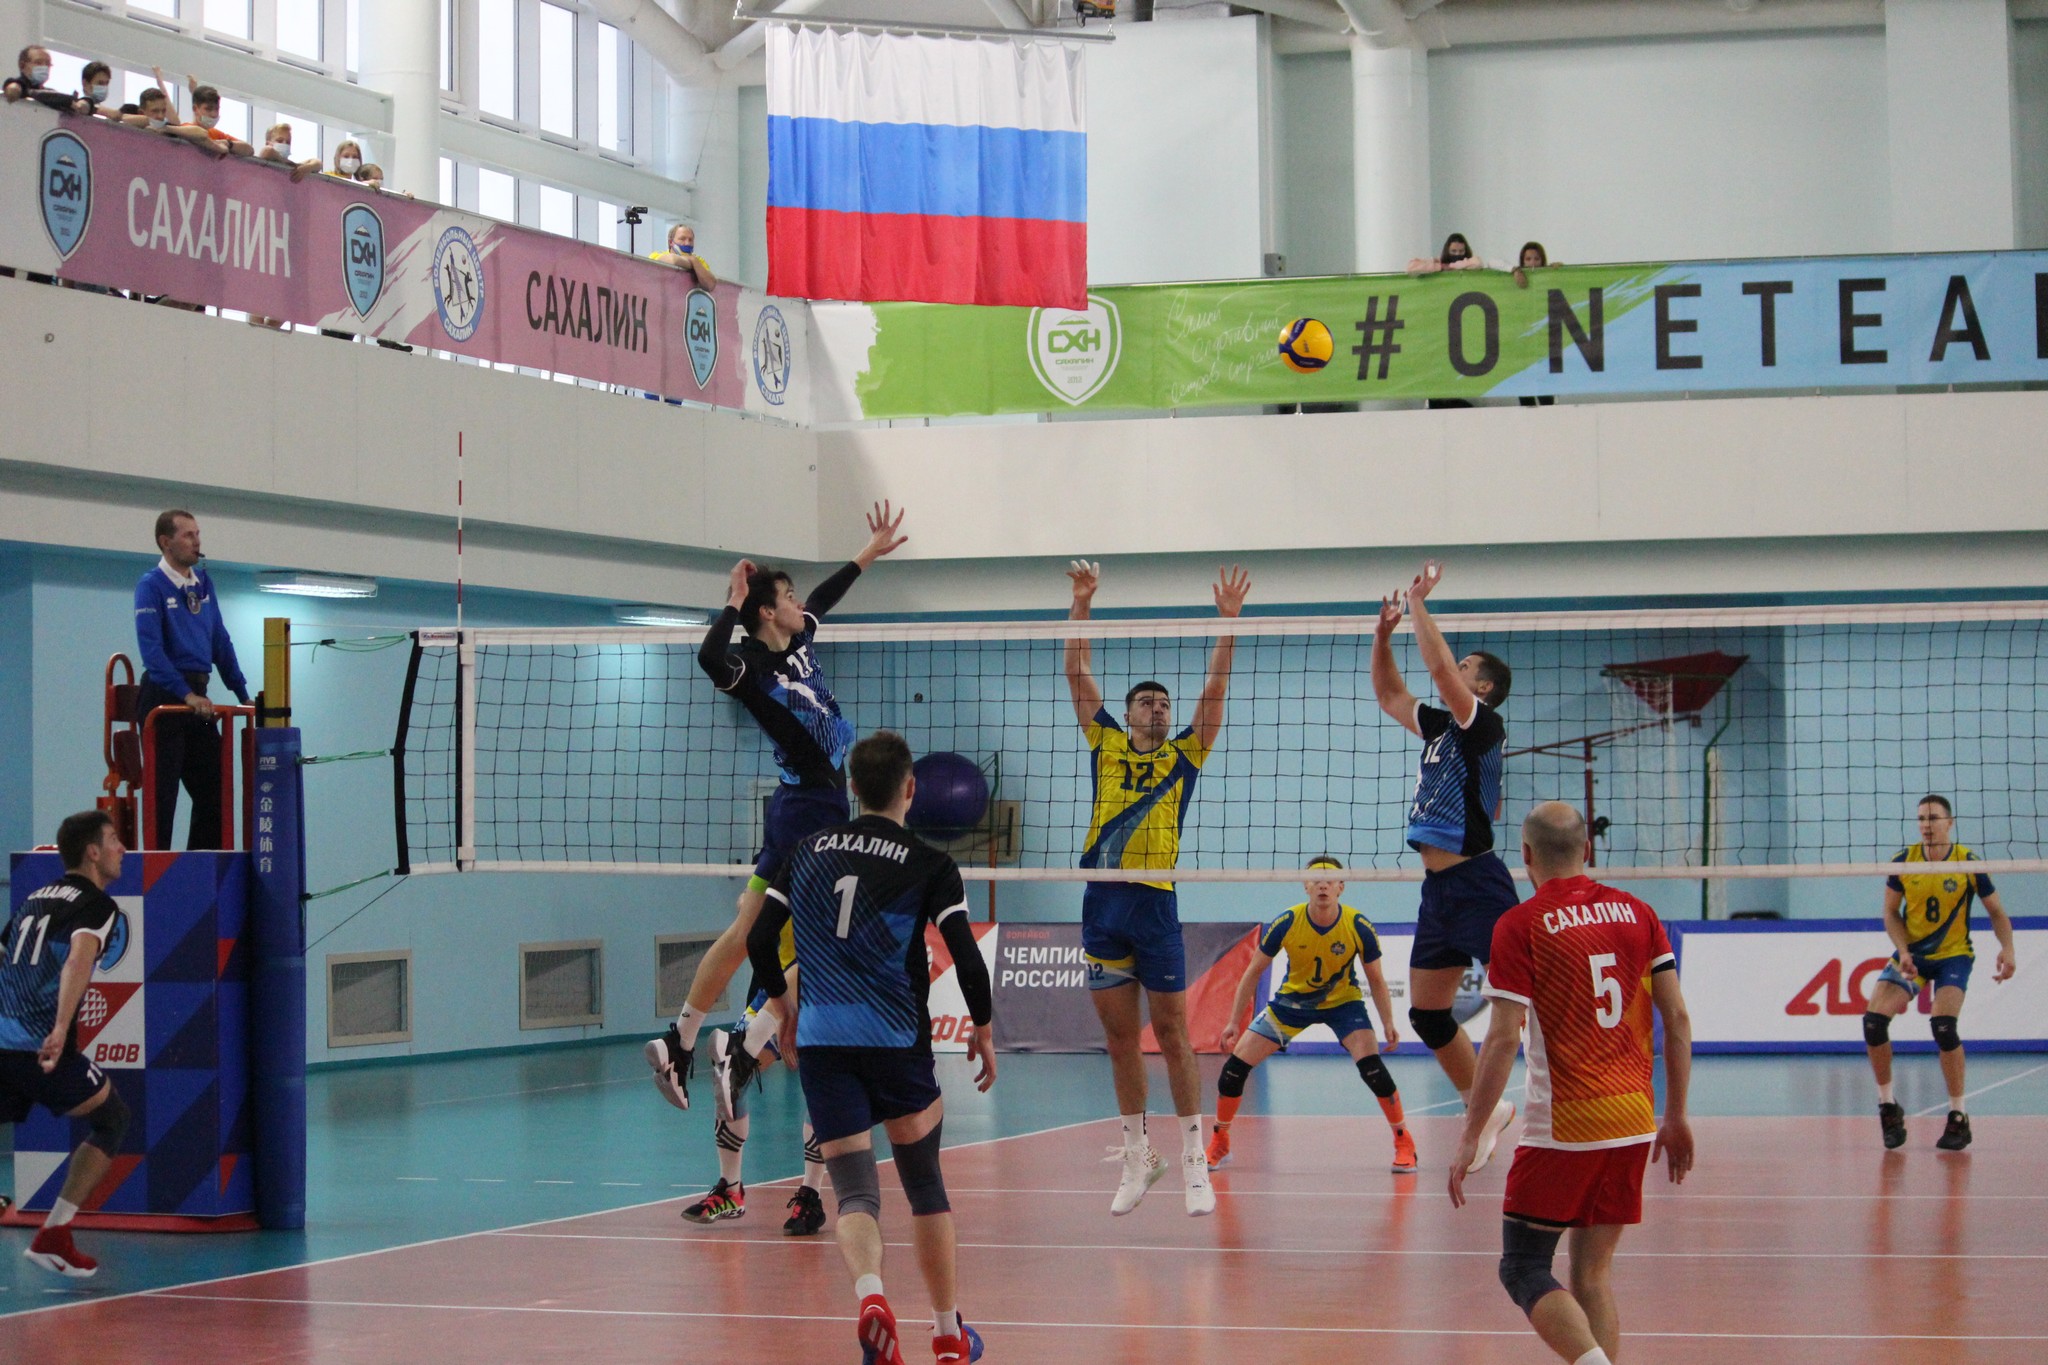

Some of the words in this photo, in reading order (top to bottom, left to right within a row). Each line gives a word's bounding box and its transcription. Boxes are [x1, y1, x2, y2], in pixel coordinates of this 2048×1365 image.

[127, 177, 292, 279] САХАЛИН
[526, 270, 648, 354] САХАЛИН
[1352, 272, 2048, 381] #ONETEA
[443, 317, 474, 341] САХАЛИН
[1423, 732, 1447, 764] 12
[1118, 758, 1155, 793] 12
[259, 796, 273, 873] 金陵体育
[814, 833, 910, 865] САХАЛИН
[833, 874, 859, 939] 1
[1542, 901, 1638, 935] САХАЛИН
[1925, 895, 1940, 924] 8
[12, 913, 52, 966] 11
[1002, 969, 1085, 988] РОССИИ
[1086, 962, 1106, 981] 12
[1311, 956, 1323, 983] 1
[1588, 952, 1623, 1029] 5
[94, 1042, 140, 1063] ВФВ
[86, 1061, 104, 1086] 11
